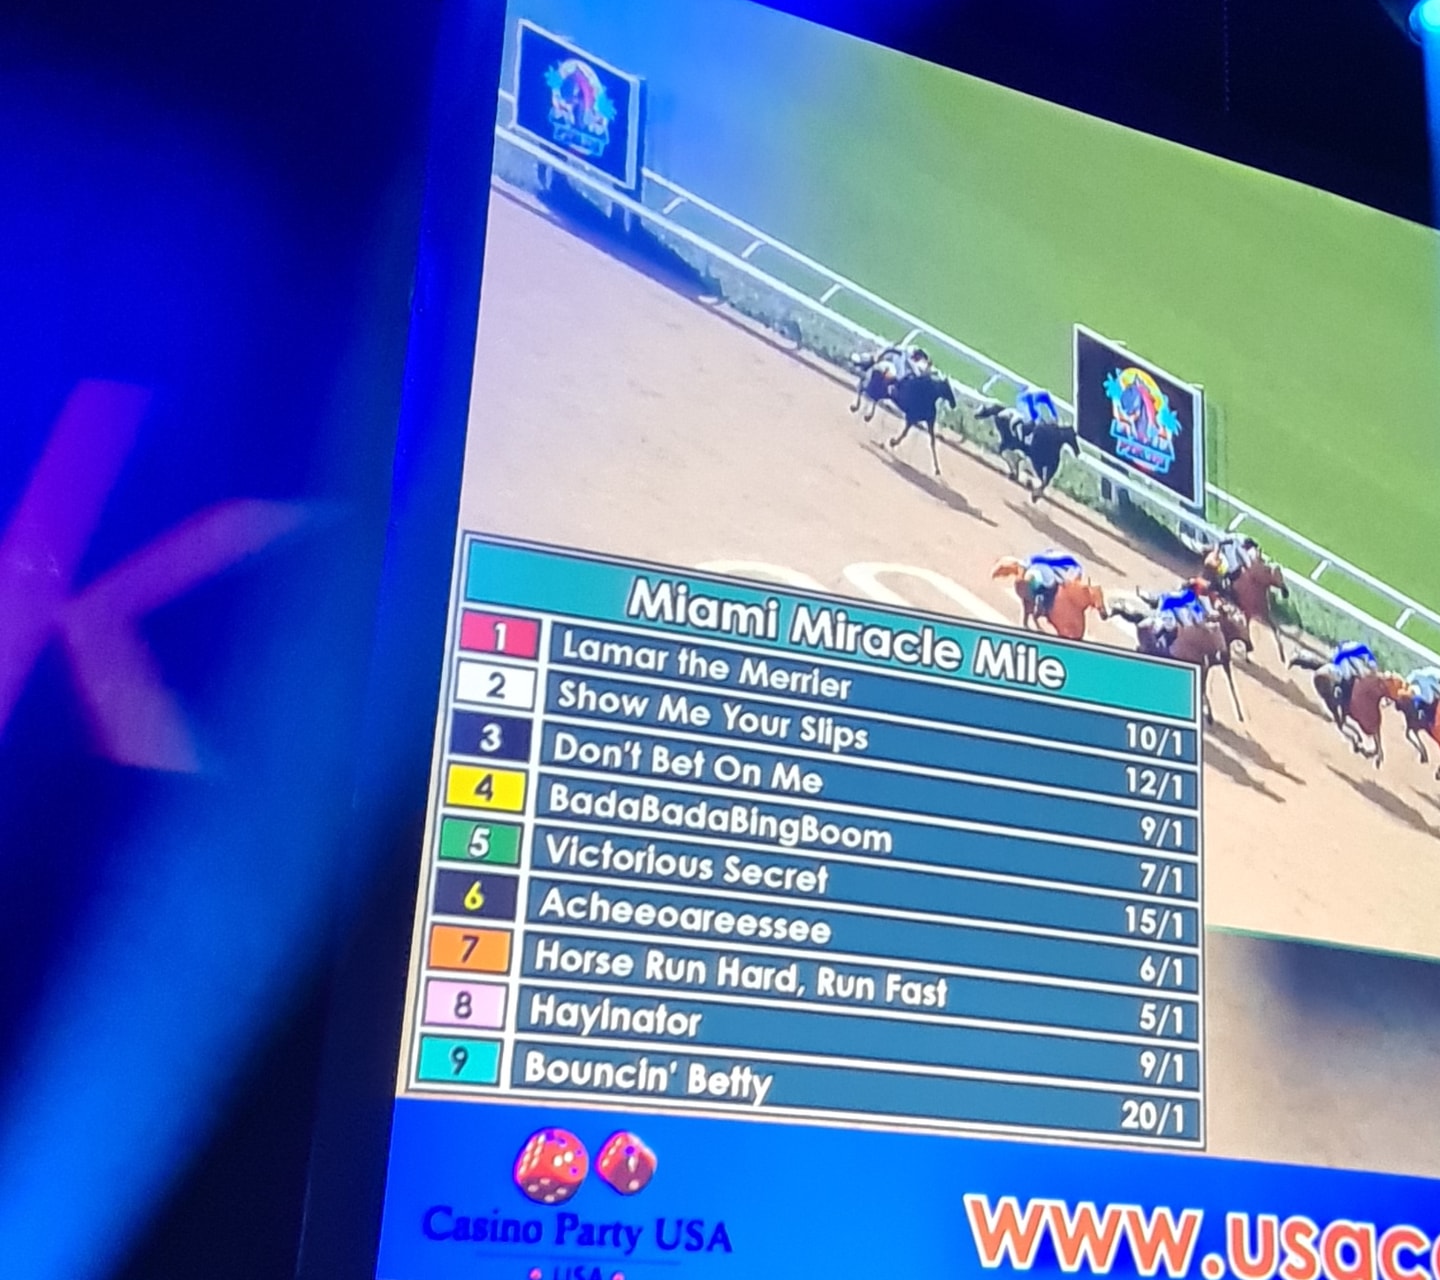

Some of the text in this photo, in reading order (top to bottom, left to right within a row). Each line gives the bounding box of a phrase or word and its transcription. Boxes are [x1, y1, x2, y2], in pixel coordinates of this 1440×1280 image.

[493, 623, 506, 651] 1
[627, 577, 1067, 689] Miami Miracle Mile
[562, 630, 852, 700] Lamar the Merrier
[486, 672, 506, 699] 2
[558, 680, 869, 753] Show Me Your Slips
[480, 724, 502, 751] 3
[1125, 722, 1183, 756] 10/1
[554, 732, 823, 795] Don't Bet On Me
[474, 774, 494, 801] 4
[1125, 767, 1183, 801] 12/1
[550, 783, 893, 853] BadaBadaBingBoom
[1140, 817, 1183, 848] 9/1
[468, 827, 491, 858] 5
[546, 833, 829, 894] Victorious Secret
[1140, 863, 1183, 894] 7/1
[464, 881, 484, 910] 6
[539, 887, 831, 944] Acheeoareessee
[1125, 905, 1183, 939] 15/1
[460, 935, 479, 963] 7
[535, 939, 948, 1008] Horse Run Hard, Run Fast
[1139, 956, 1183, 987] 6/1
[453, 991, 473, 1019] 8
[1139, 1003, 1183, 1035] 5/1
[450, 1046, 468, 1075] 9
[1139, 1051, 1183, 1084] 9/1
[525, 1051, 774, 1107] Bouncin' Betty
[1121, 1100, 1184, 1135] 20/1
[421, 1205, 733, 1257] Casino Party USA
